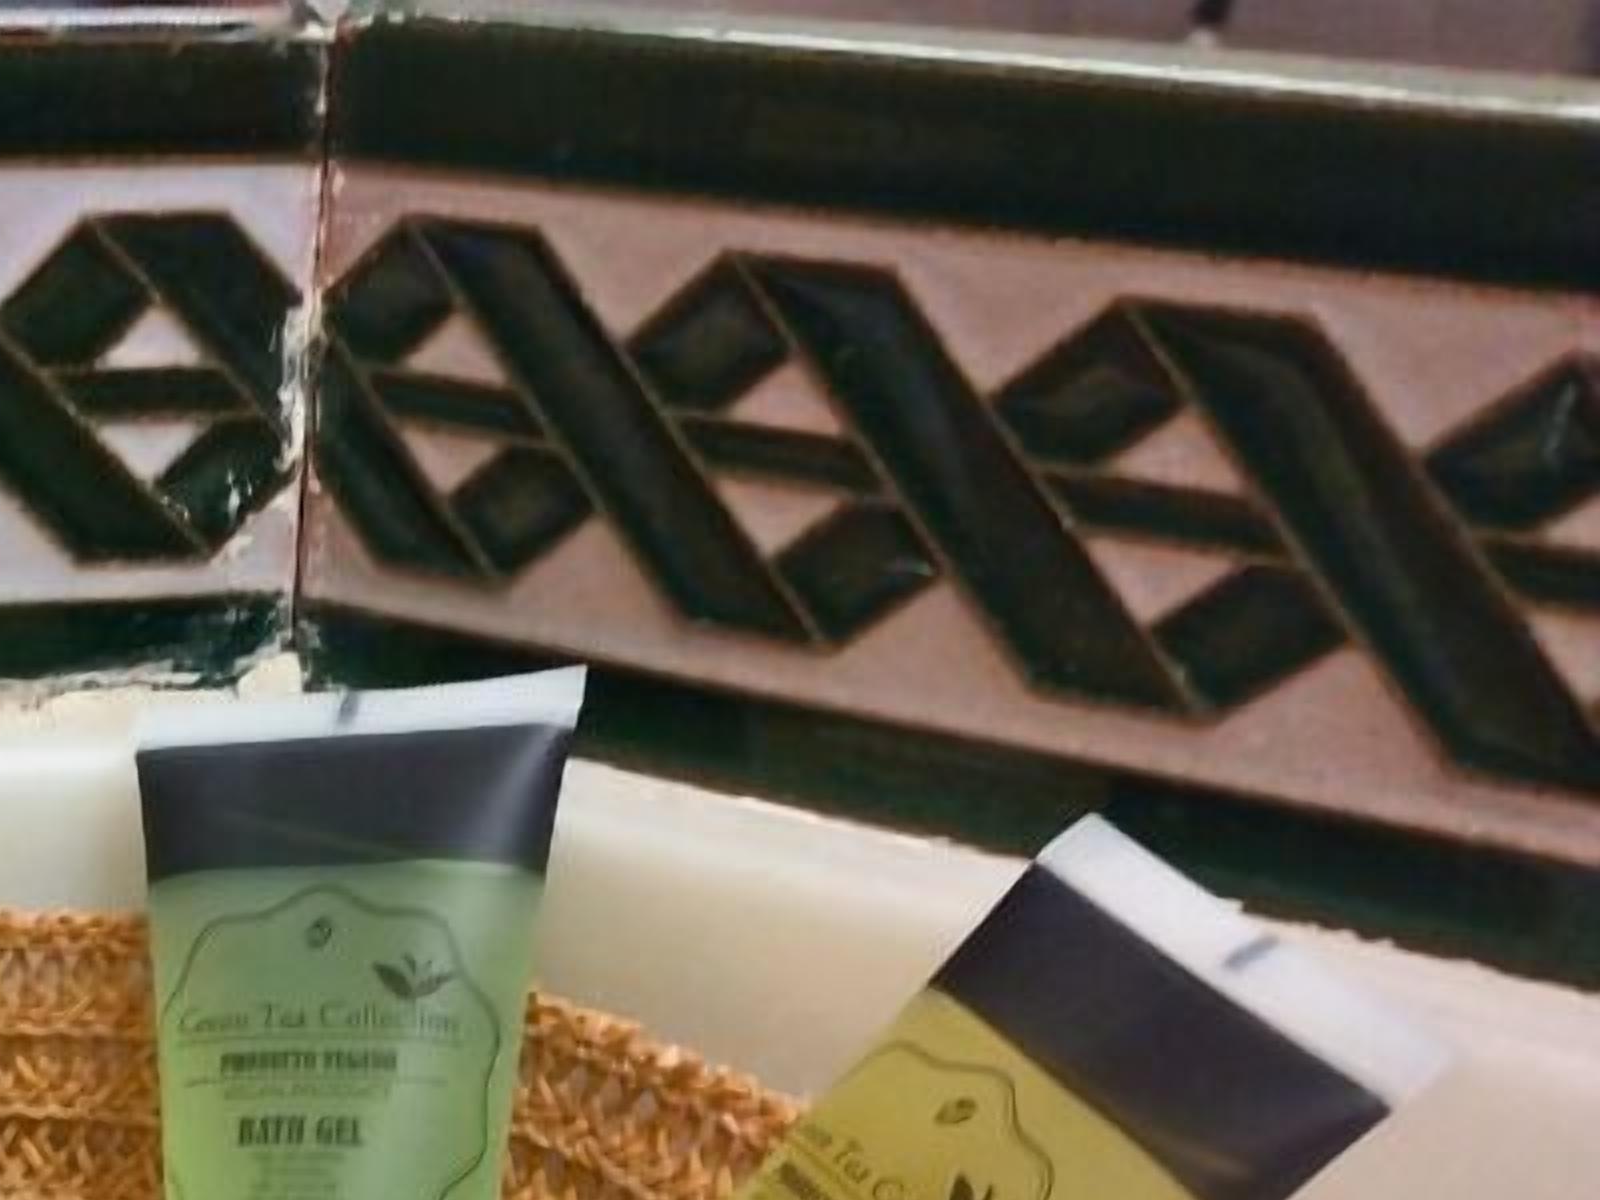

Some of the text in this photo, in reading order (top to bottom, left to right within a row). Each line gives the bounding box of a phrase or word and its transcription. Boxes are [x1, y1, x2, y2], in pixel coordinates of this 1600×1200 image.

[260, 1001, 305, 1026] Tea
[239, 1116, 363, 1146] BATH GEL
